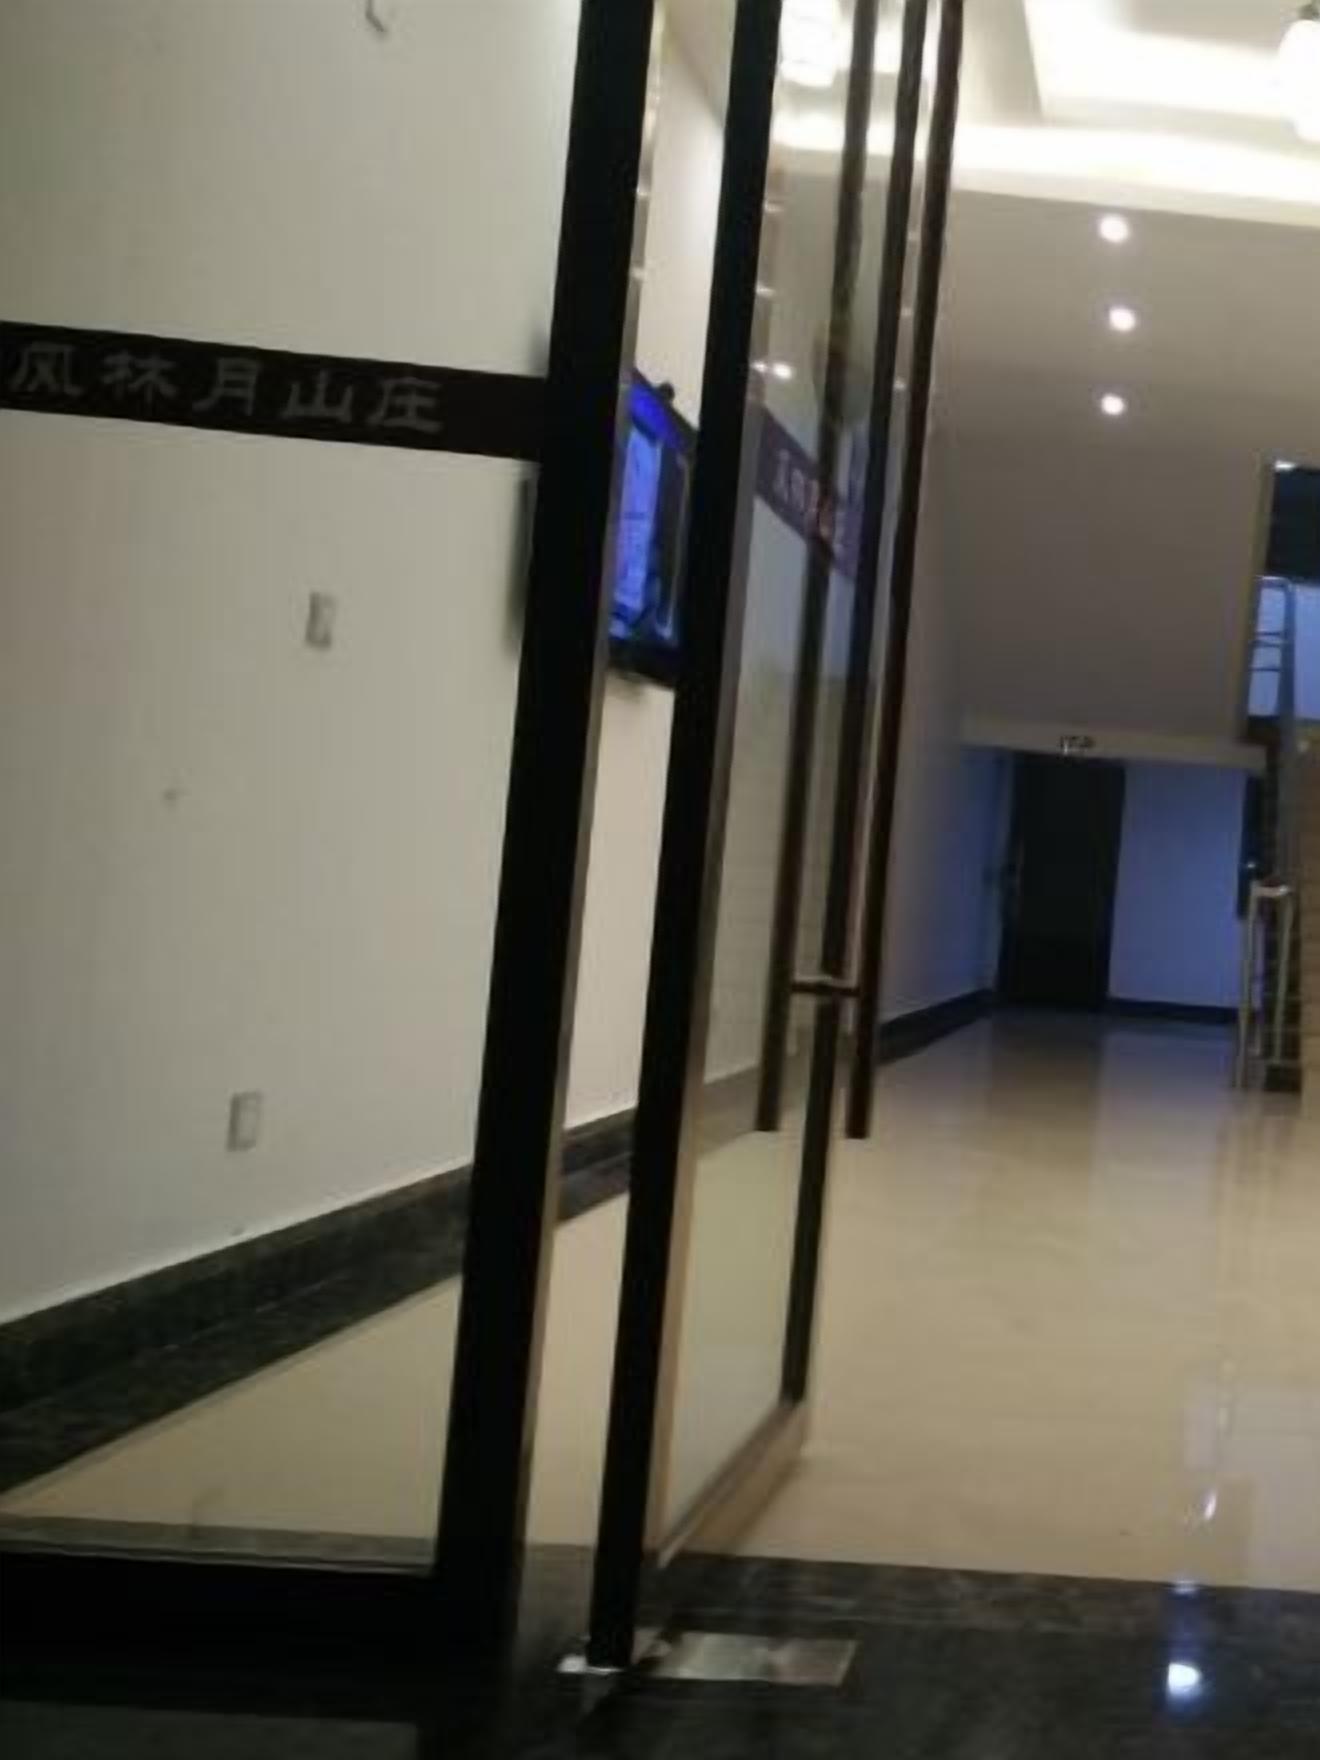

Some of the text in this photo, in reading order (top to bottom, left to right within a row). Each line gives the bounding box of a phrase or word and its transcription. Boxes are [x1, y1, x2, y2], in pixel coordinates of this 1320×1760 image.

[8, 341, 445, 434] 风林月山庄
